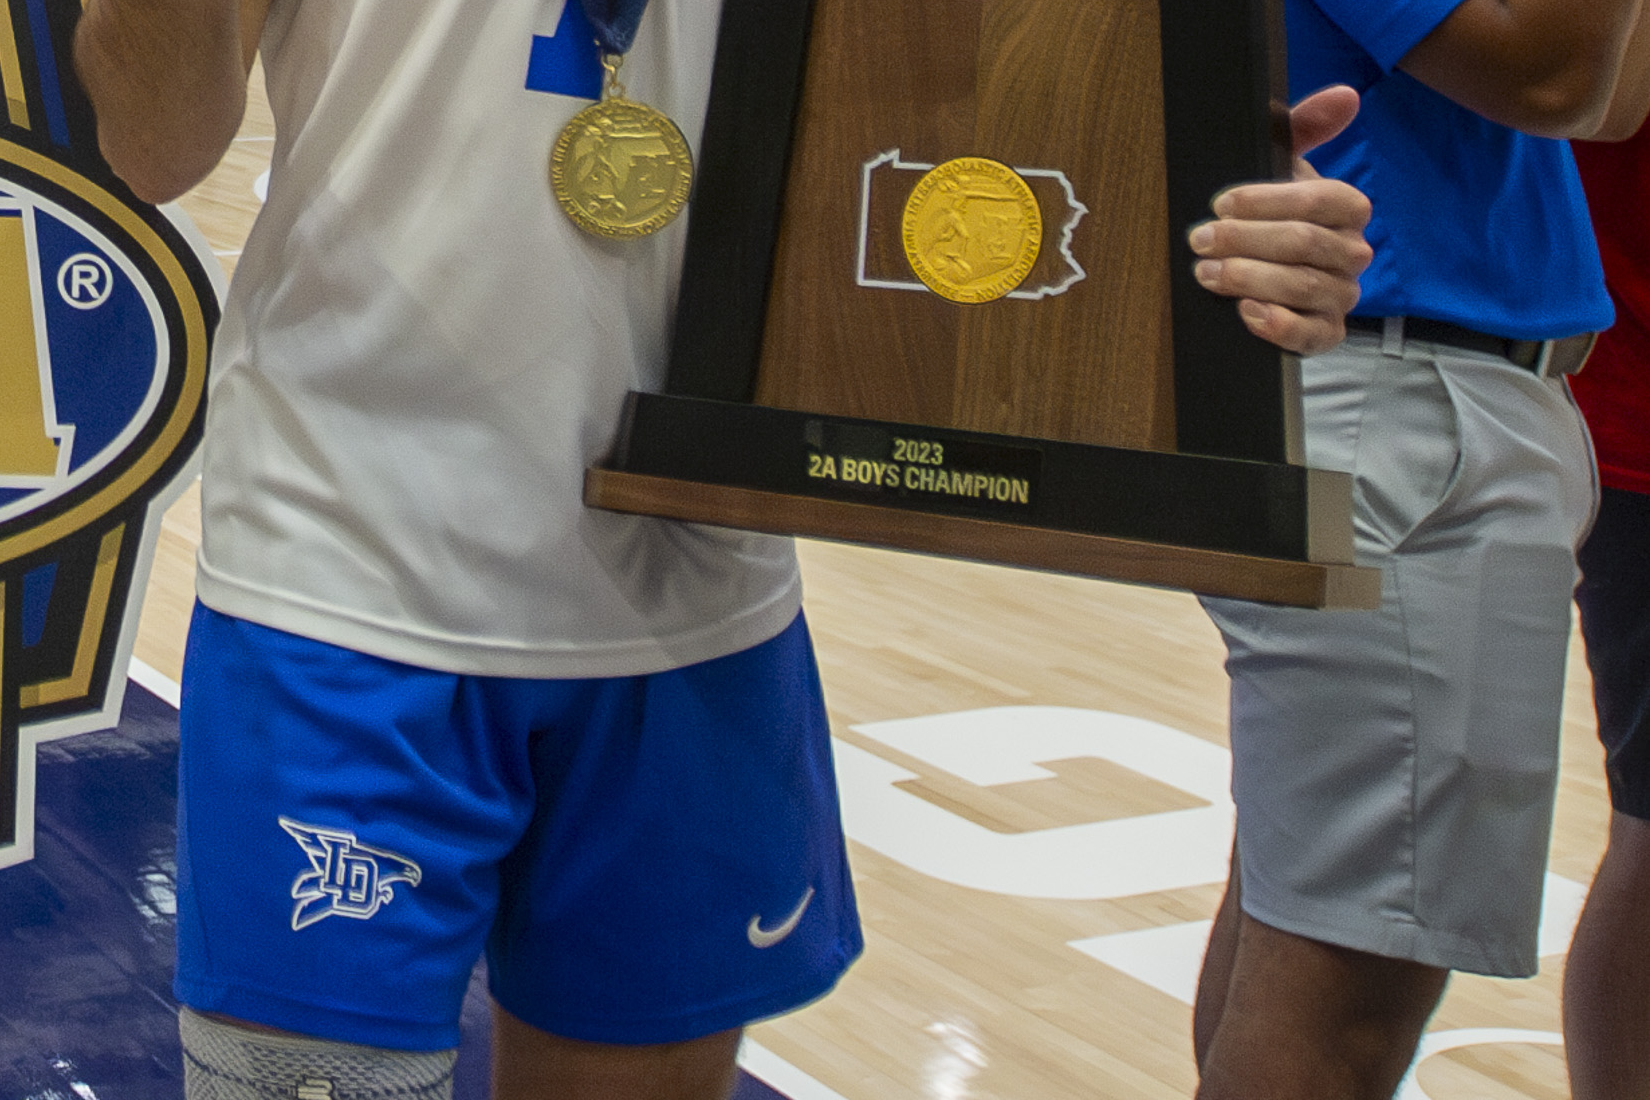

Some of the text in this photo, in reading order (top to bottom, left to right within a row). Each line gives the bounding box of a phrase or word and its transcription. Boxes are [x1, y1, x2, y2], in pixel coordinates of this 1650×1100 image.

[892, 438, 945, 466] 2023
[807, 453, 1030, 505] 2A BOYS CHAMPION
